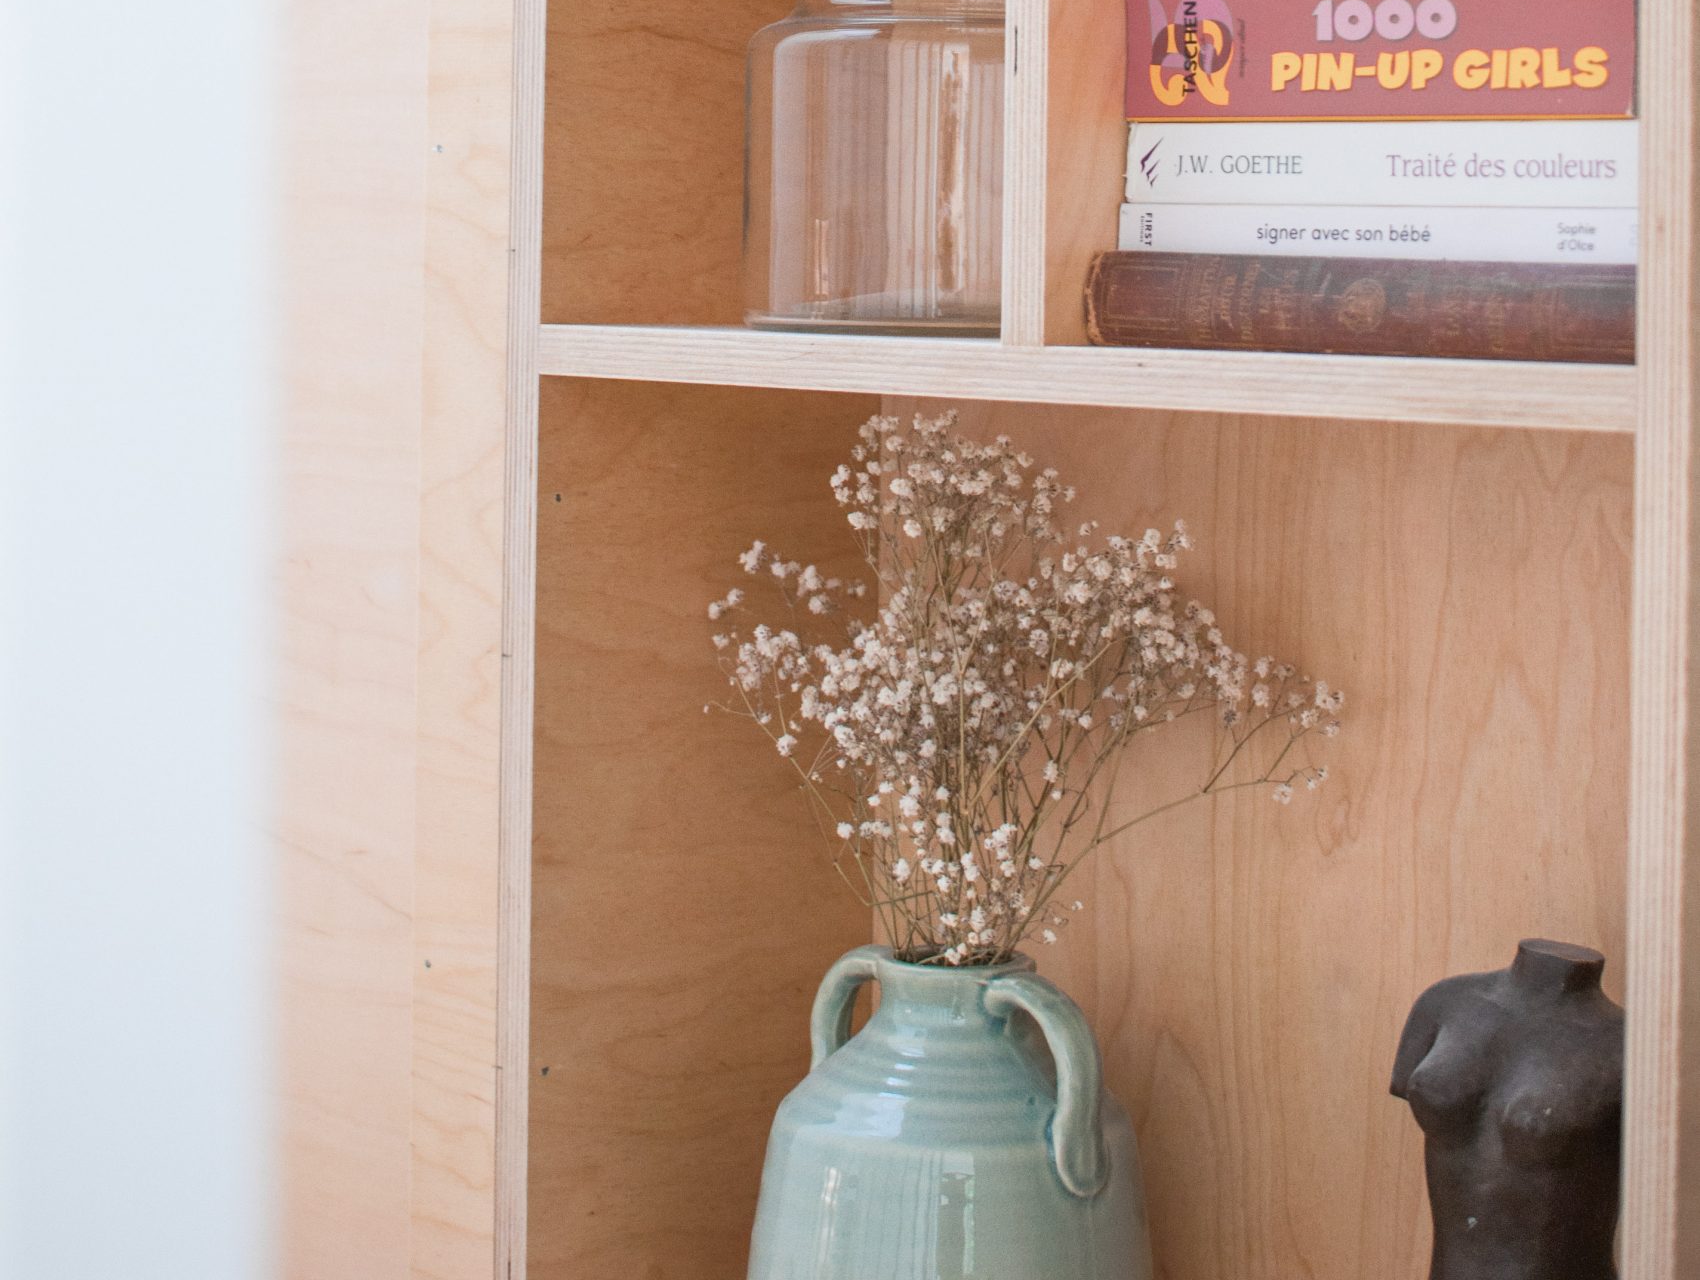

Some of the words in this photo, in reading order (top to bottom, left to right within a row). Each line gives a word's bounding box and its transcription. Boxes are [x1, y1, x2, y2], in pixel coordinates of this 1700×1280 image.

[1181, 0, 1198, 97] TASCHEN
[1270, 48, 1444, 92] PIN-UP
[1453, 45, 1609, 90] GIRLS
[1220, 154, 1304, 174] GOETHE
[1386, 152, 1457, 178] Traité
[1464, 152, 1506, 178] des
[1513, 152, 1617, 178] couleurs
[1144, 212, 1153, 247] FIRST
[1256, 223, 1307, 245] signer
[1311, 227, 1350, 242] avec
[1356, 227, 1383, 242] son
[1389, 224, 1431, 242] bébé
[1557, 222, 1597, 237] Sophie
